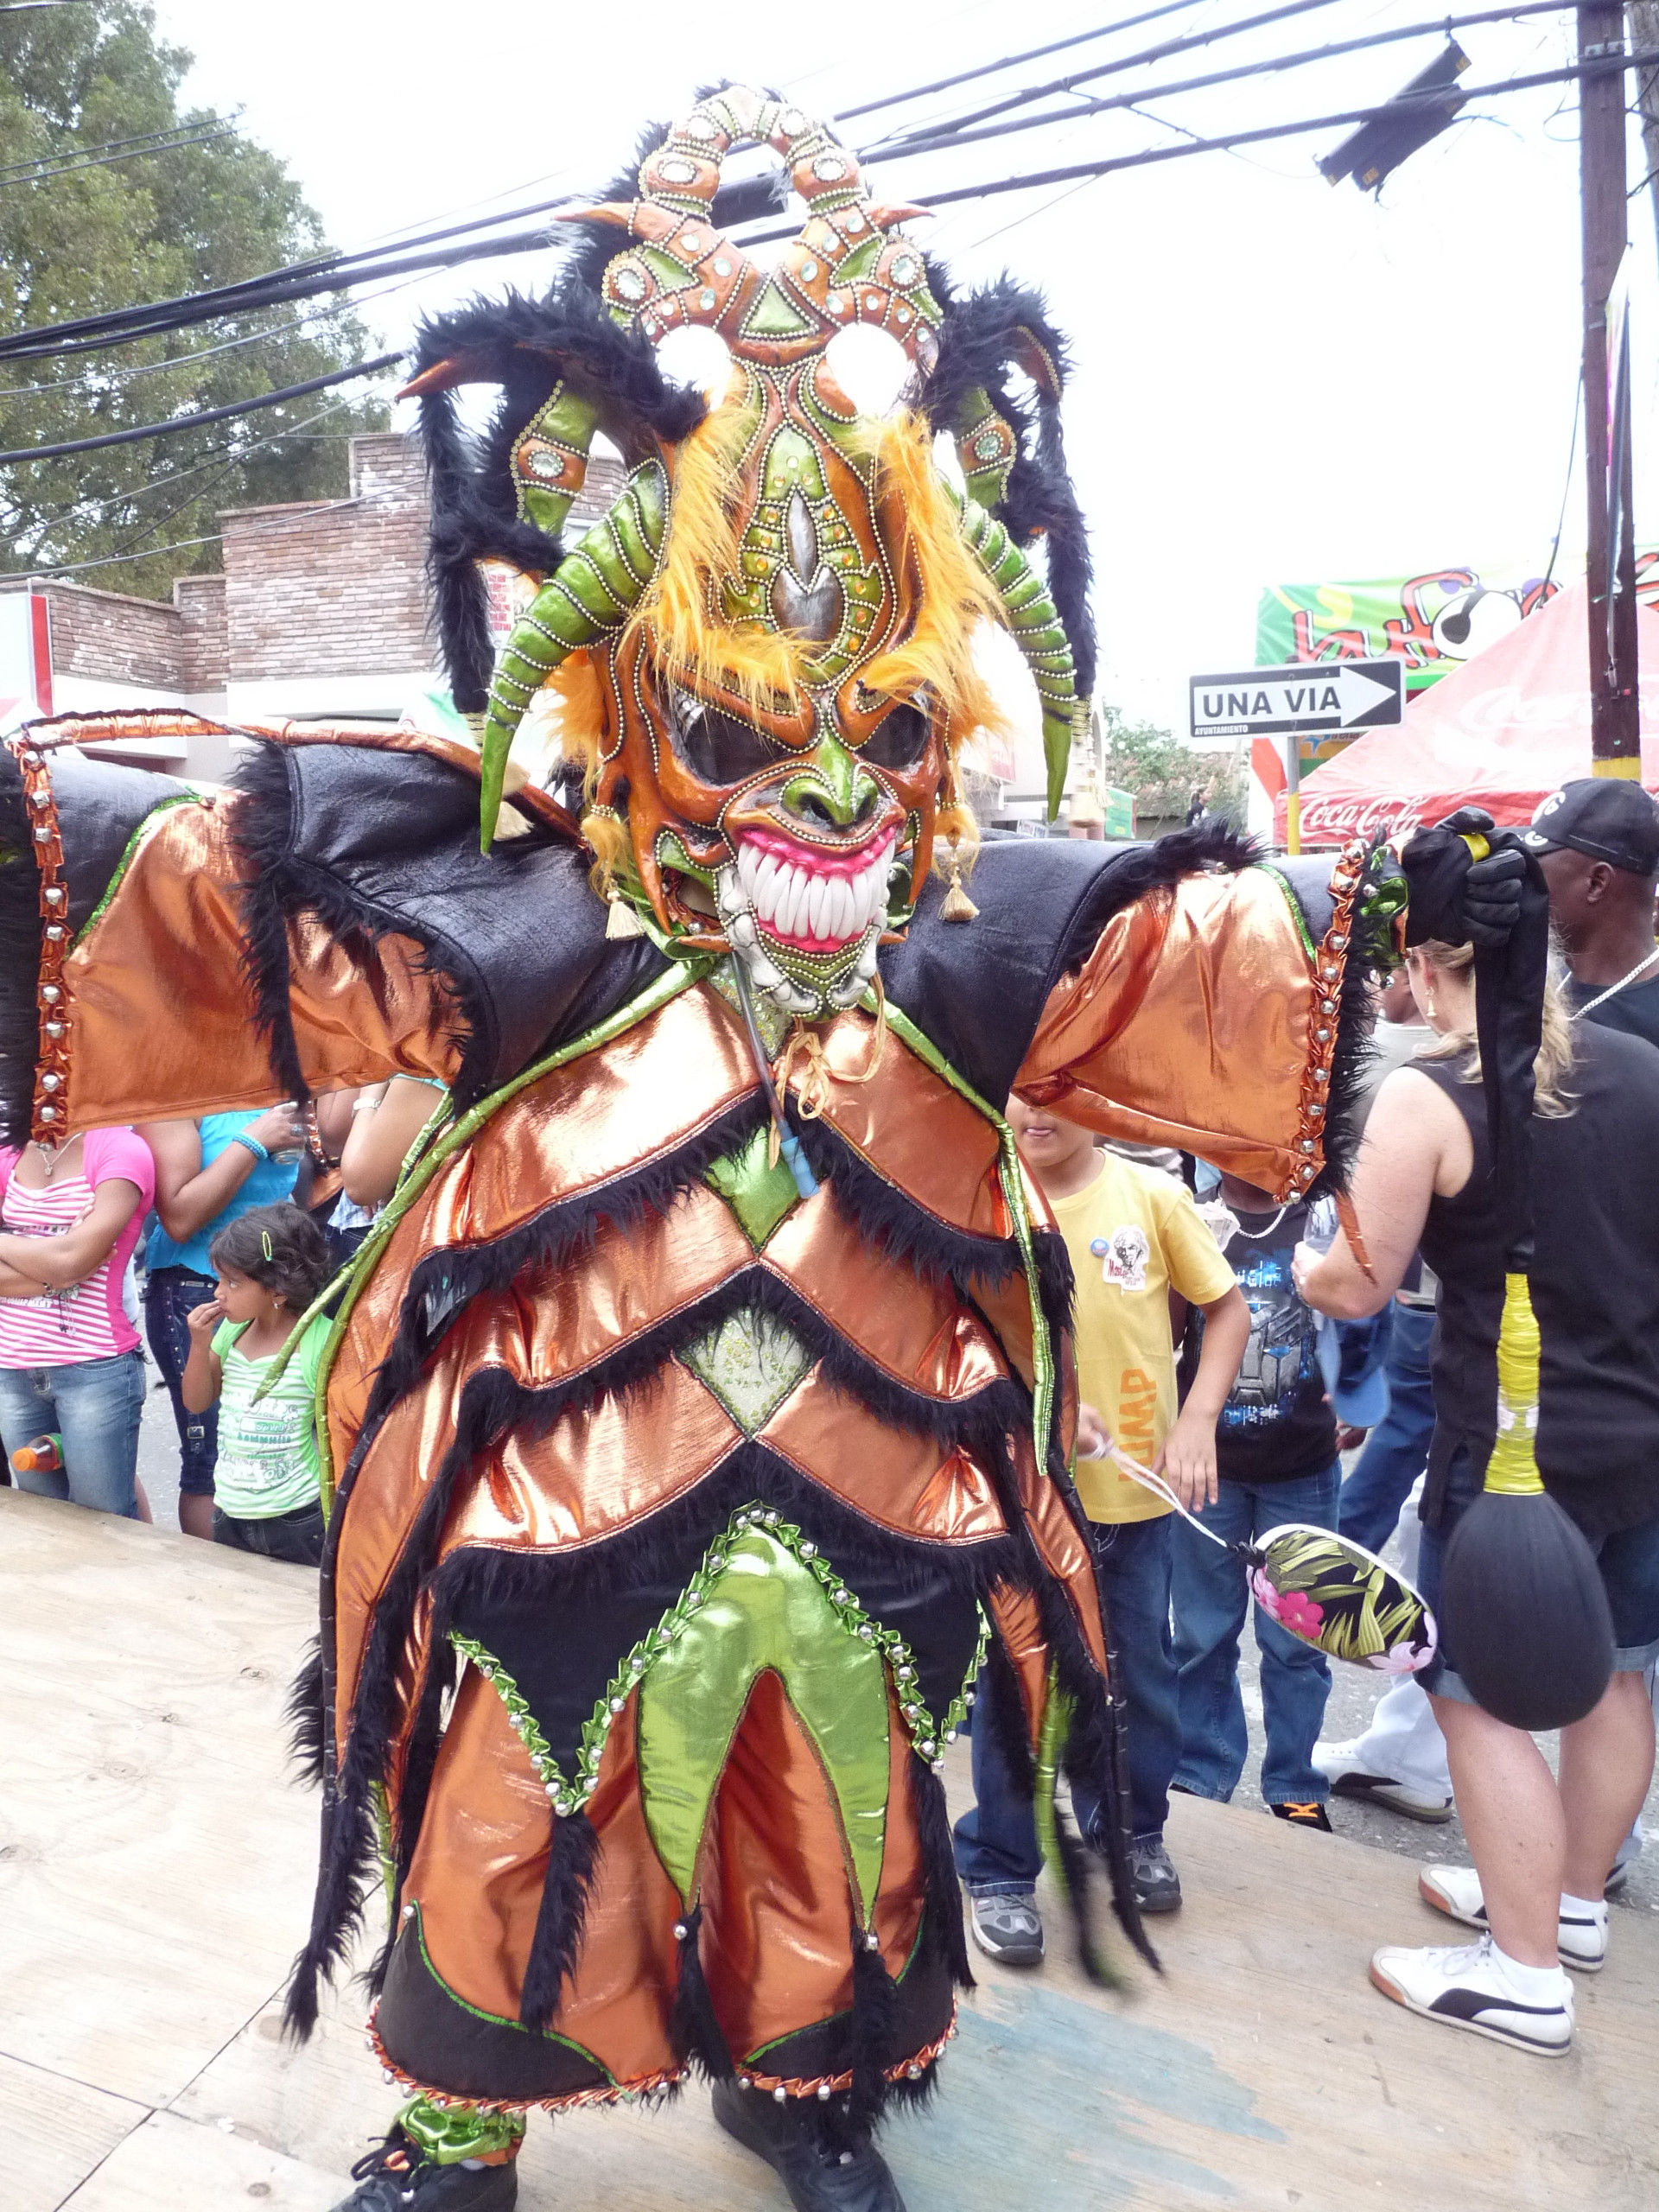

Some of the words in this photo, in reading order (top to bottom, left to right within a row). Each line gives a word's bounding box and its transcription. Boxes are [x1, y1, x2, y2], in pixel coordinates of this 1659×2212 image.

[1202, 690, 1273, 718] UNA
[1283, 685, 1342, 713] VIA
[1194, 724, 1249, 735] AYUNTAMIENTO
